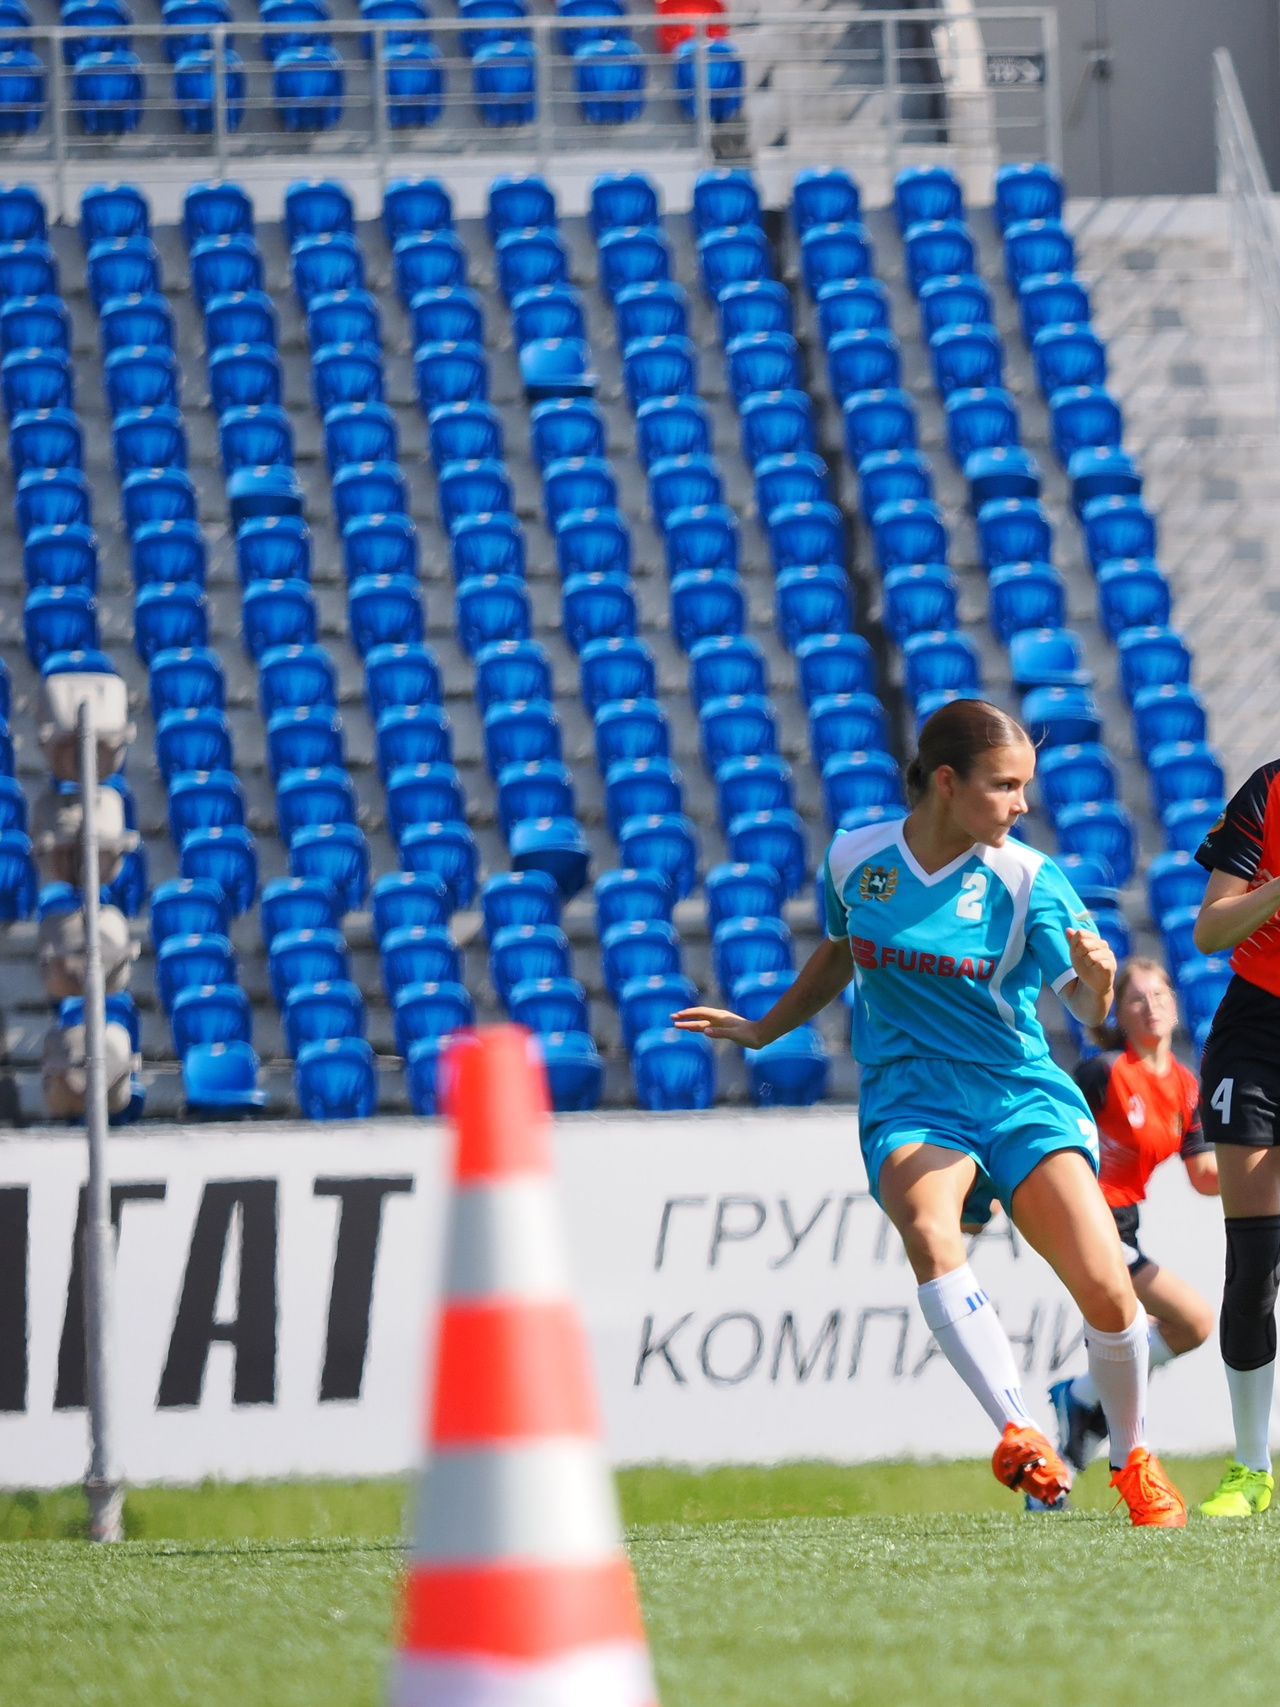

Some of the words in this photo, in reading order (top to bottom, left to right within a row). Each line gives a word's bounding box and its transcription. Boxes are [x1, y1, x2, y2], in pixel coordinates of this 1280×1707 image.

[956, 872, 987, 920] 2
[881, 947, 995, 980] FURBAU
[1210, 1077, 1234, 1124] 4
[0, 1174, 414, 1412] ГАТ
